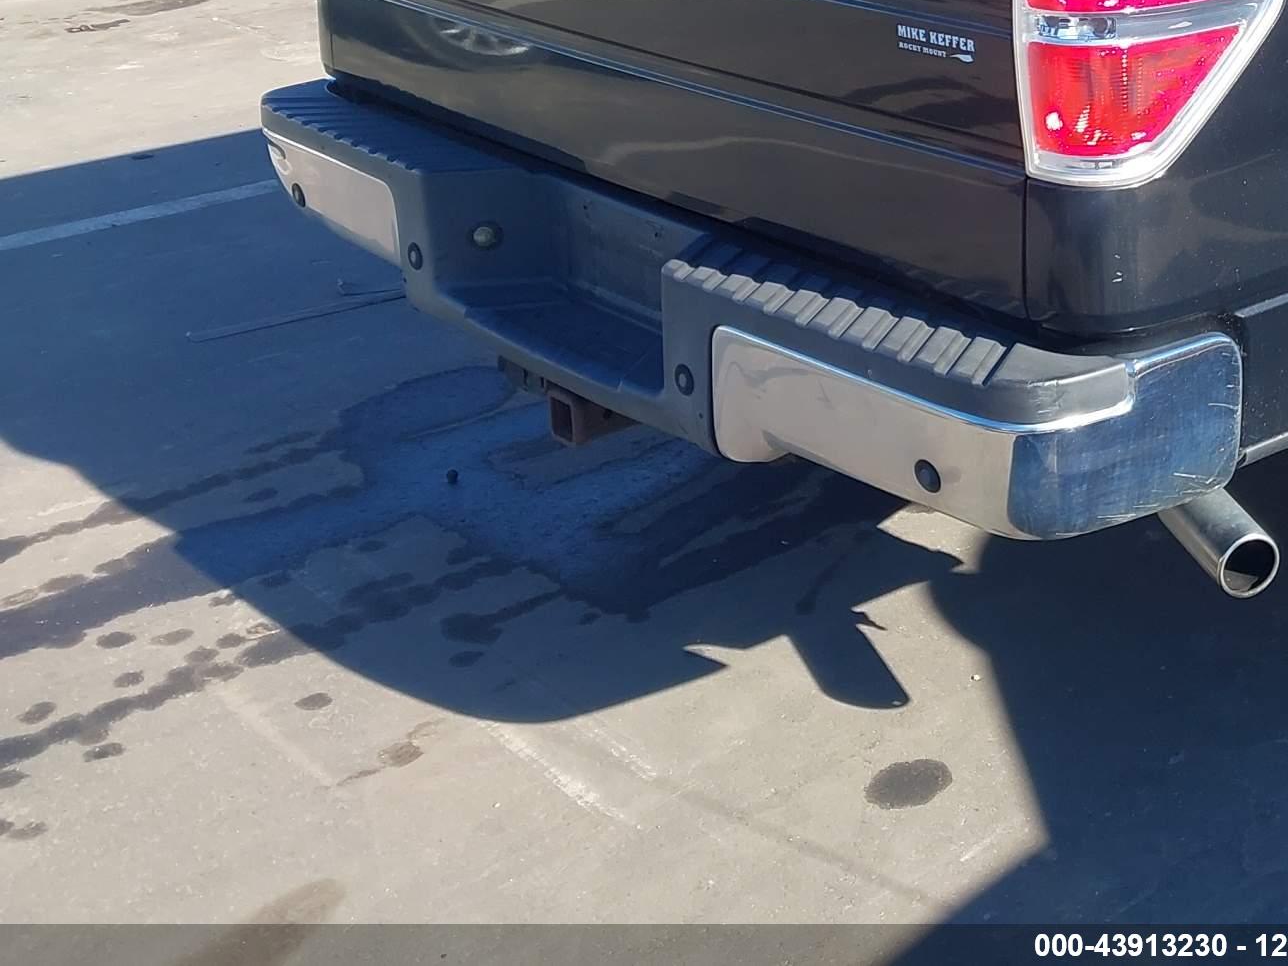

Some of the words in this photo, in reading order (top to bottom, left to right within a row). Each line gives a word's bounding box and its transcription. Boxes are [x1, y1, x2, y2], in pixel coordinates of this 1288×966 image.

[897, 24, 926, 42] MIKE
[929, 31, 975, 52] KEFFER
[899, 41, 921, 52] ROCKY
[922, 46, 947, 58] MOUNT
